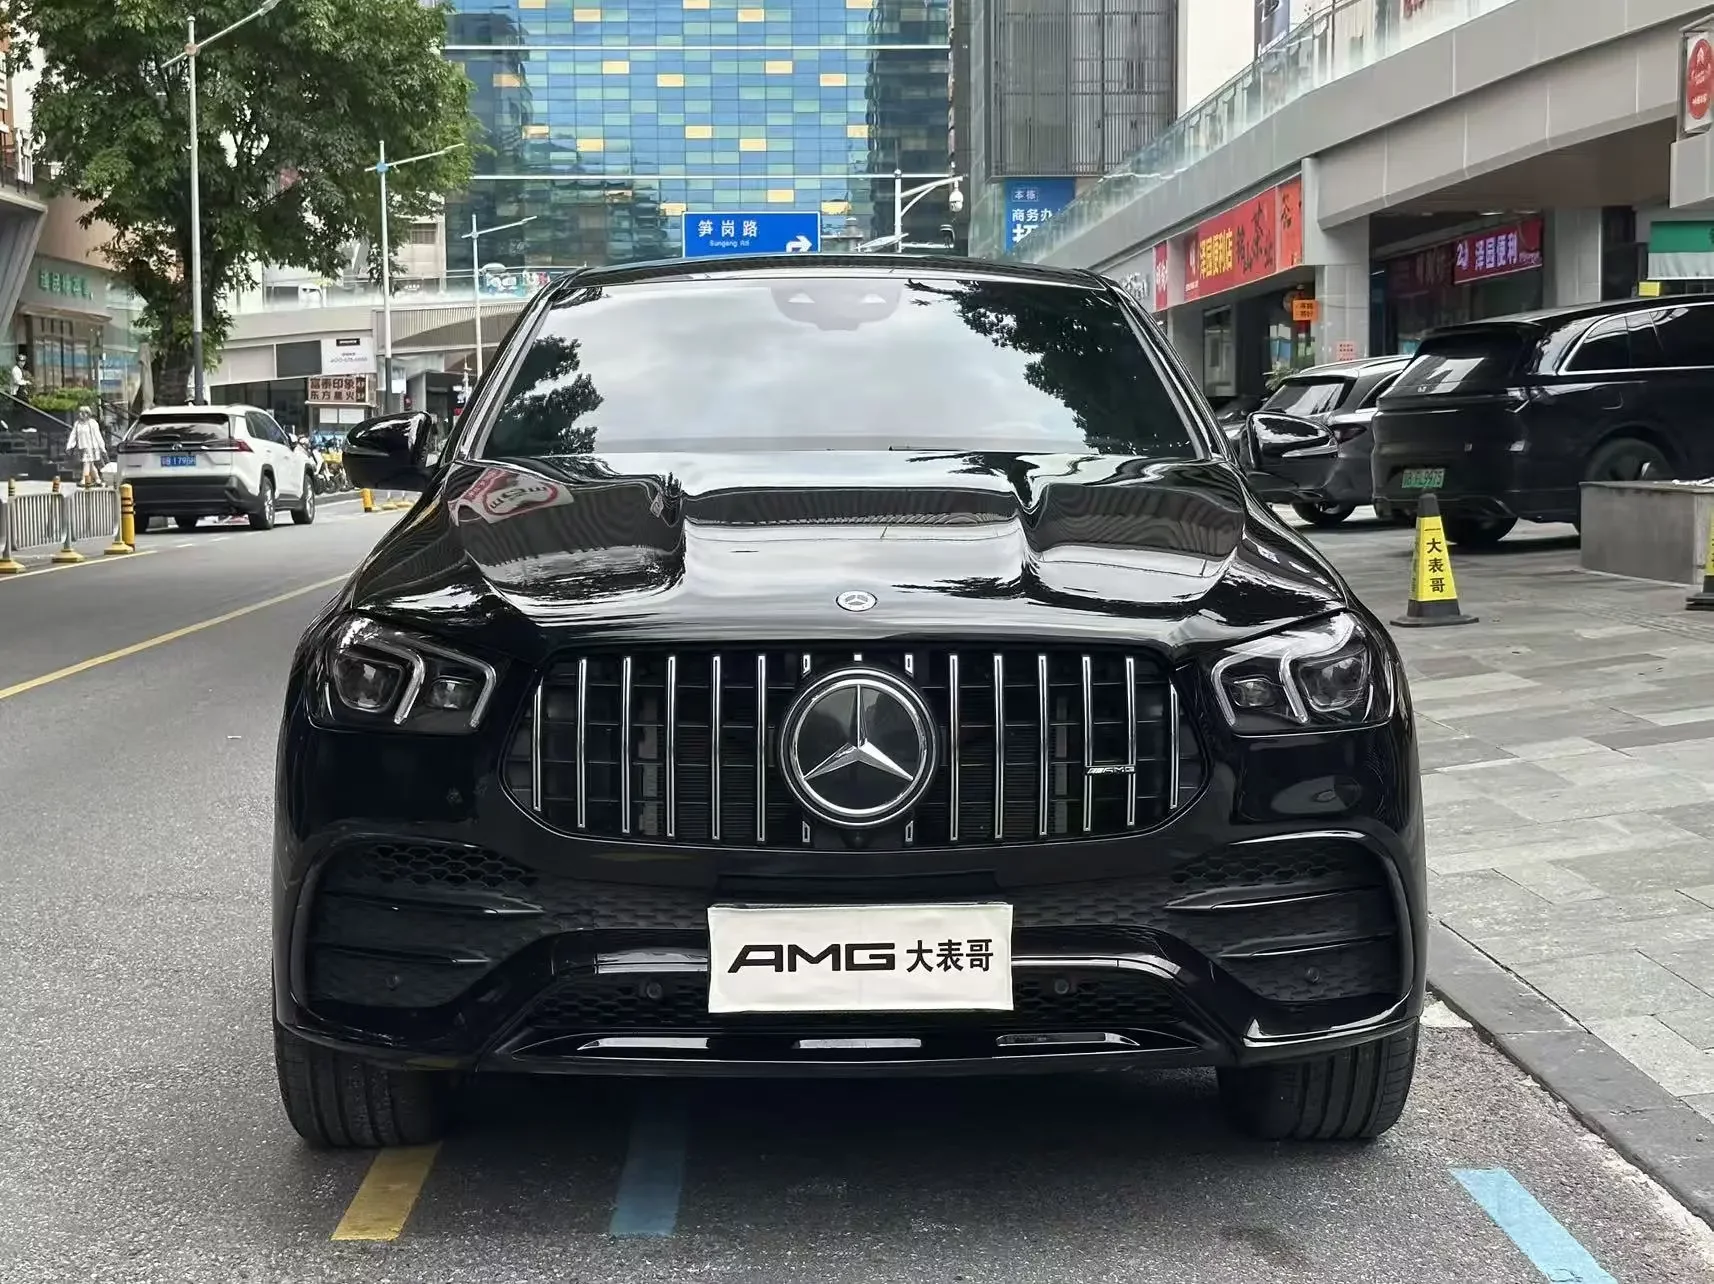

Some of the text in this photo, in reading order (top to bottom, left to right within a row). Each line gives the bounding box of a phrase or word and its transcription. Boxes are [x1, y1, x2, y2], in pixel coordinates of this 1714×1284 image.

[698, 219, 758, 238] 笋岗路
[1012, 208, 1061, 222] 商务办
[1426, 538, 1446, 593] 大表哥
[727, 938, 994, 973] AMG 大表哥
